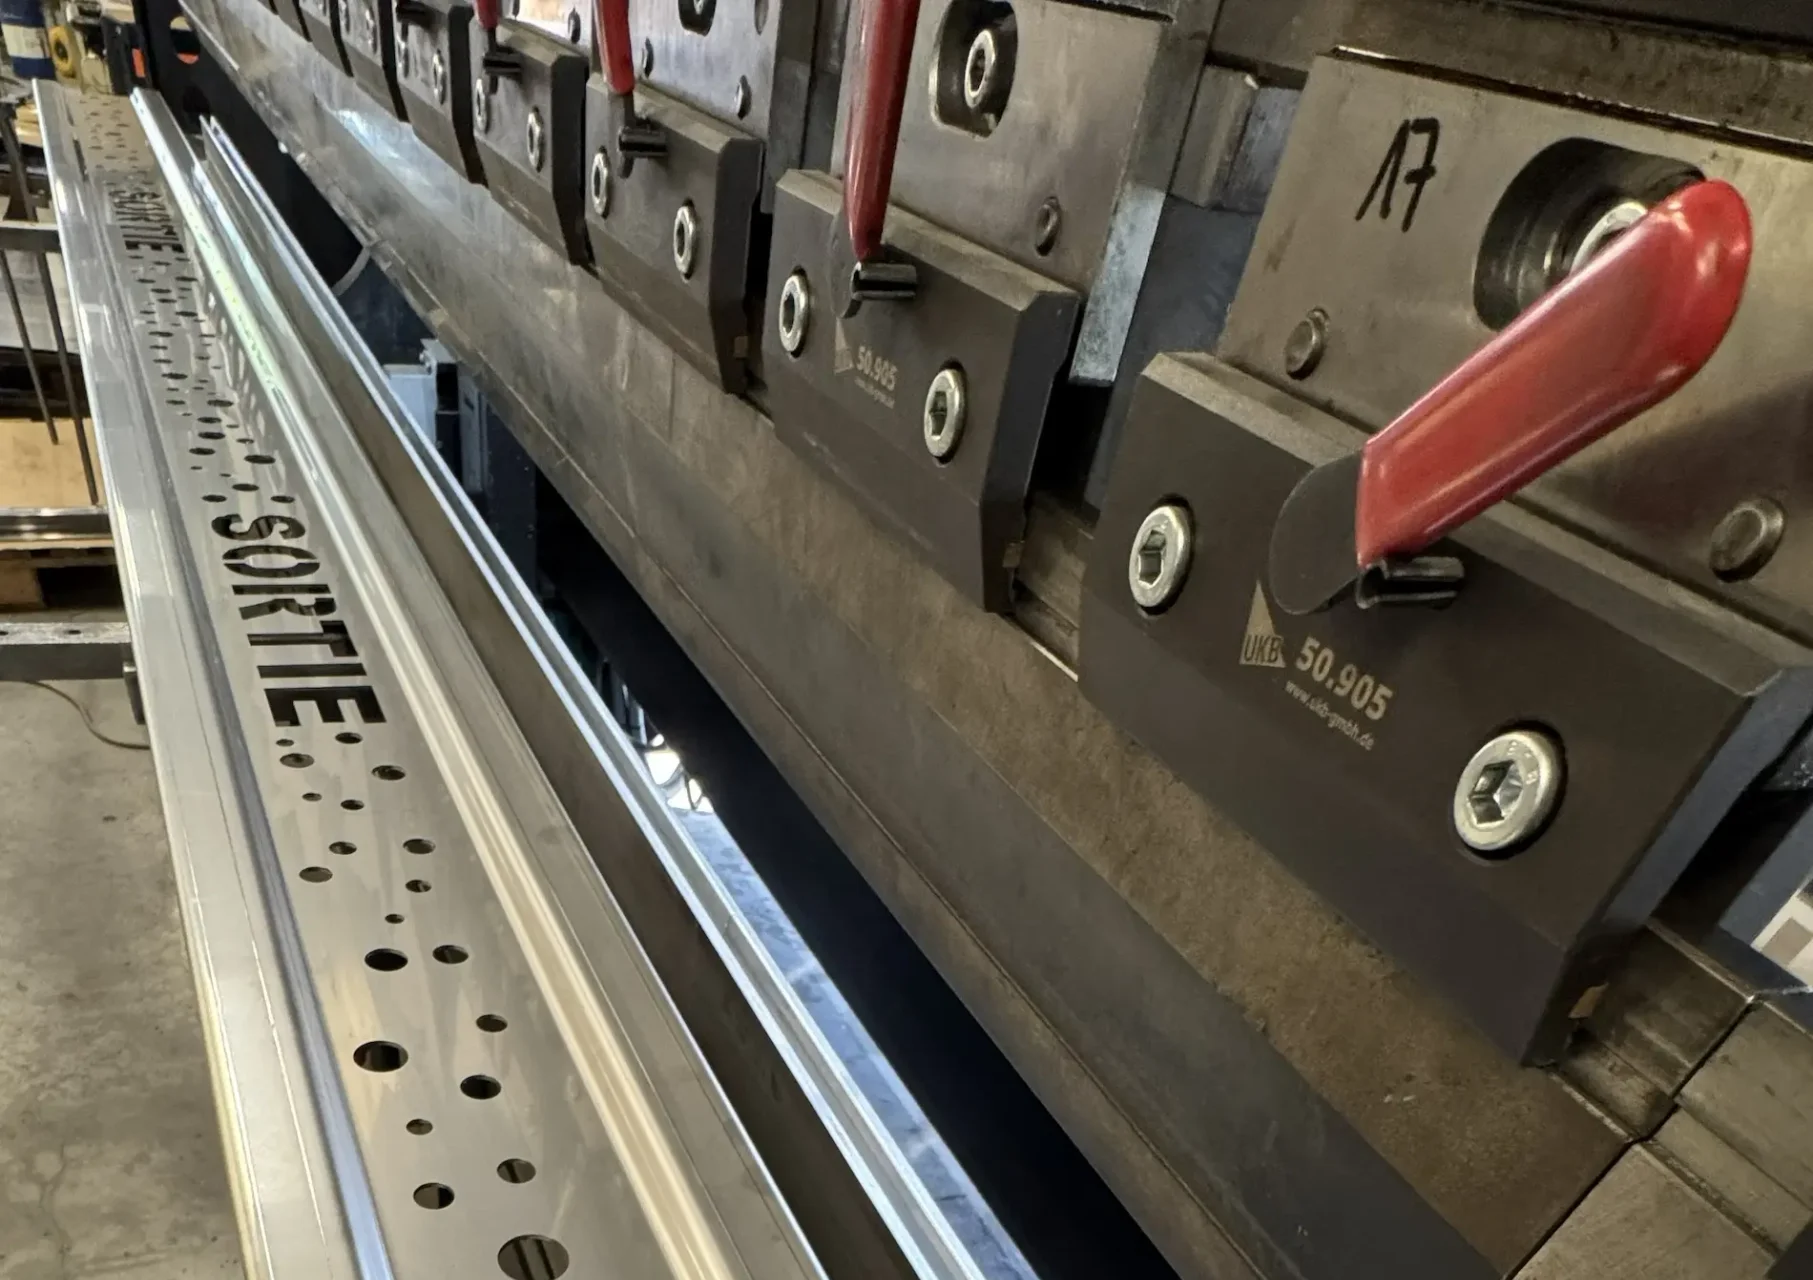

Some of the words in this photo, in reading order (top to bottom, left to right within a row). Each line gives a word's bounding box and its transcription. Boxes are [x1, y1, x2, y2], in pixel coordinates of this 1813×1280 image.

[109, 190, 184, 253] SORTIE
[856, 346, 898, 391] 50.905
[211, 513, 387, 727] SORTIE
[1244, 634, 1283, 663] UKB
[1295, 636, 1393, 720] 50.905
